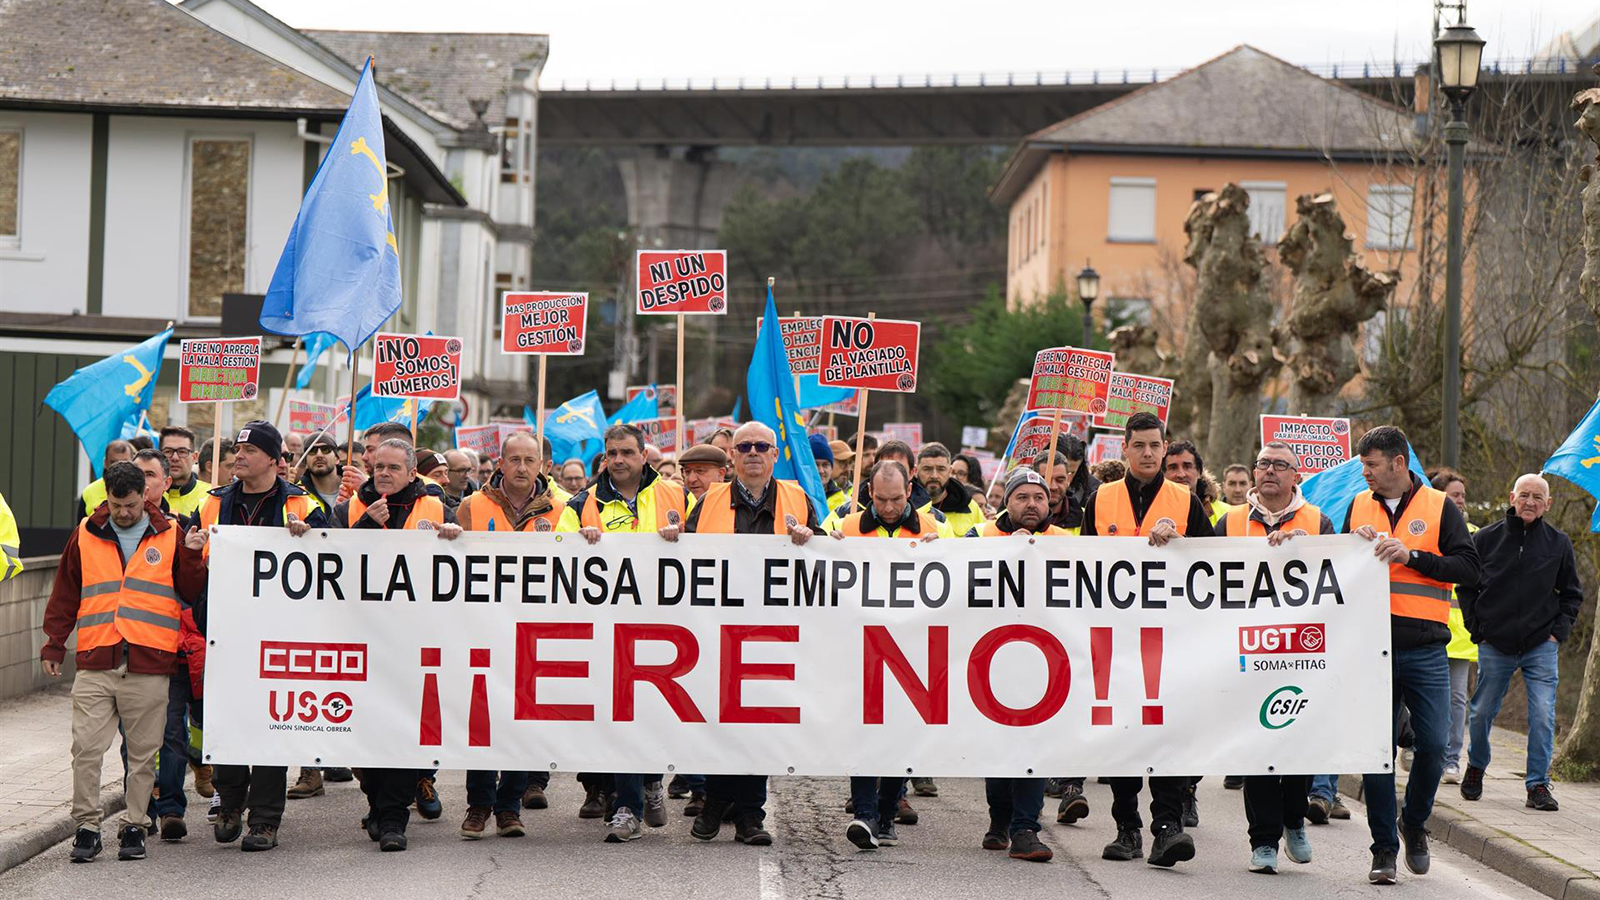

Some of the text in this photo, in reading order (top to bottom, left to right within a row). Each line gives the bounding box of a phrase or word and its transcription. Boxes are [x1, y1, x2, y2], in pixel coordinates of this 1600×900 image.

[650, 254, 705, 283] NI UN
[641, 274, 724, 308] DESPIDO
[506, 304, 524, 314] MAS
[521, 310, 568, 328] MEJOR
[518, 325, 576, 347] GESTIÓN
[783, 333, 815, 346] O HAY
[832, 320, 874, 349] NO
[192, 343, 207, 353] ERE
[209, 343, 222, 354] NO
[223, 343, 259, 354] ARREGLA
[378, 338, 419, 362] ¡NO
[830, 347, 905, 367] AL VACIADO
[183, 355, 194, 365] LA
[196, 355, 220, 366] MALA
[396, 355, 450, 375] SOMOS
[826, 360, 912, 381] DE PLANTILLA
[1044, 364, 1065, 375] MALA
[1055, 352, 1068, 363] NO
[1069, 355, 1112, 371] ARREGLA
[189, 367, 247, 383] DIRECTIVA
[1111, 387, 1133, 398] MALA
[1112, 375, 1171, 396] RE NO ARREGLA
[1280, 422, 1331, 435] IMPACTO
[1290, 444, 1343, 457] EFICIOS
[253, 551, 1345, 610] POR LA DEFENSA DEL EMPLEO EN ENCE-CEASA
[1242, 628, 1296, 651] UGT
[263, 648, 364, 674] CCOO
[1253, 659, 1326, 671] SOMA FITAG
[864, 624, 1163, 727] NO!!
[268, 690, 353, 723] USO
[269, 723, 293, 731] UNIÓN
